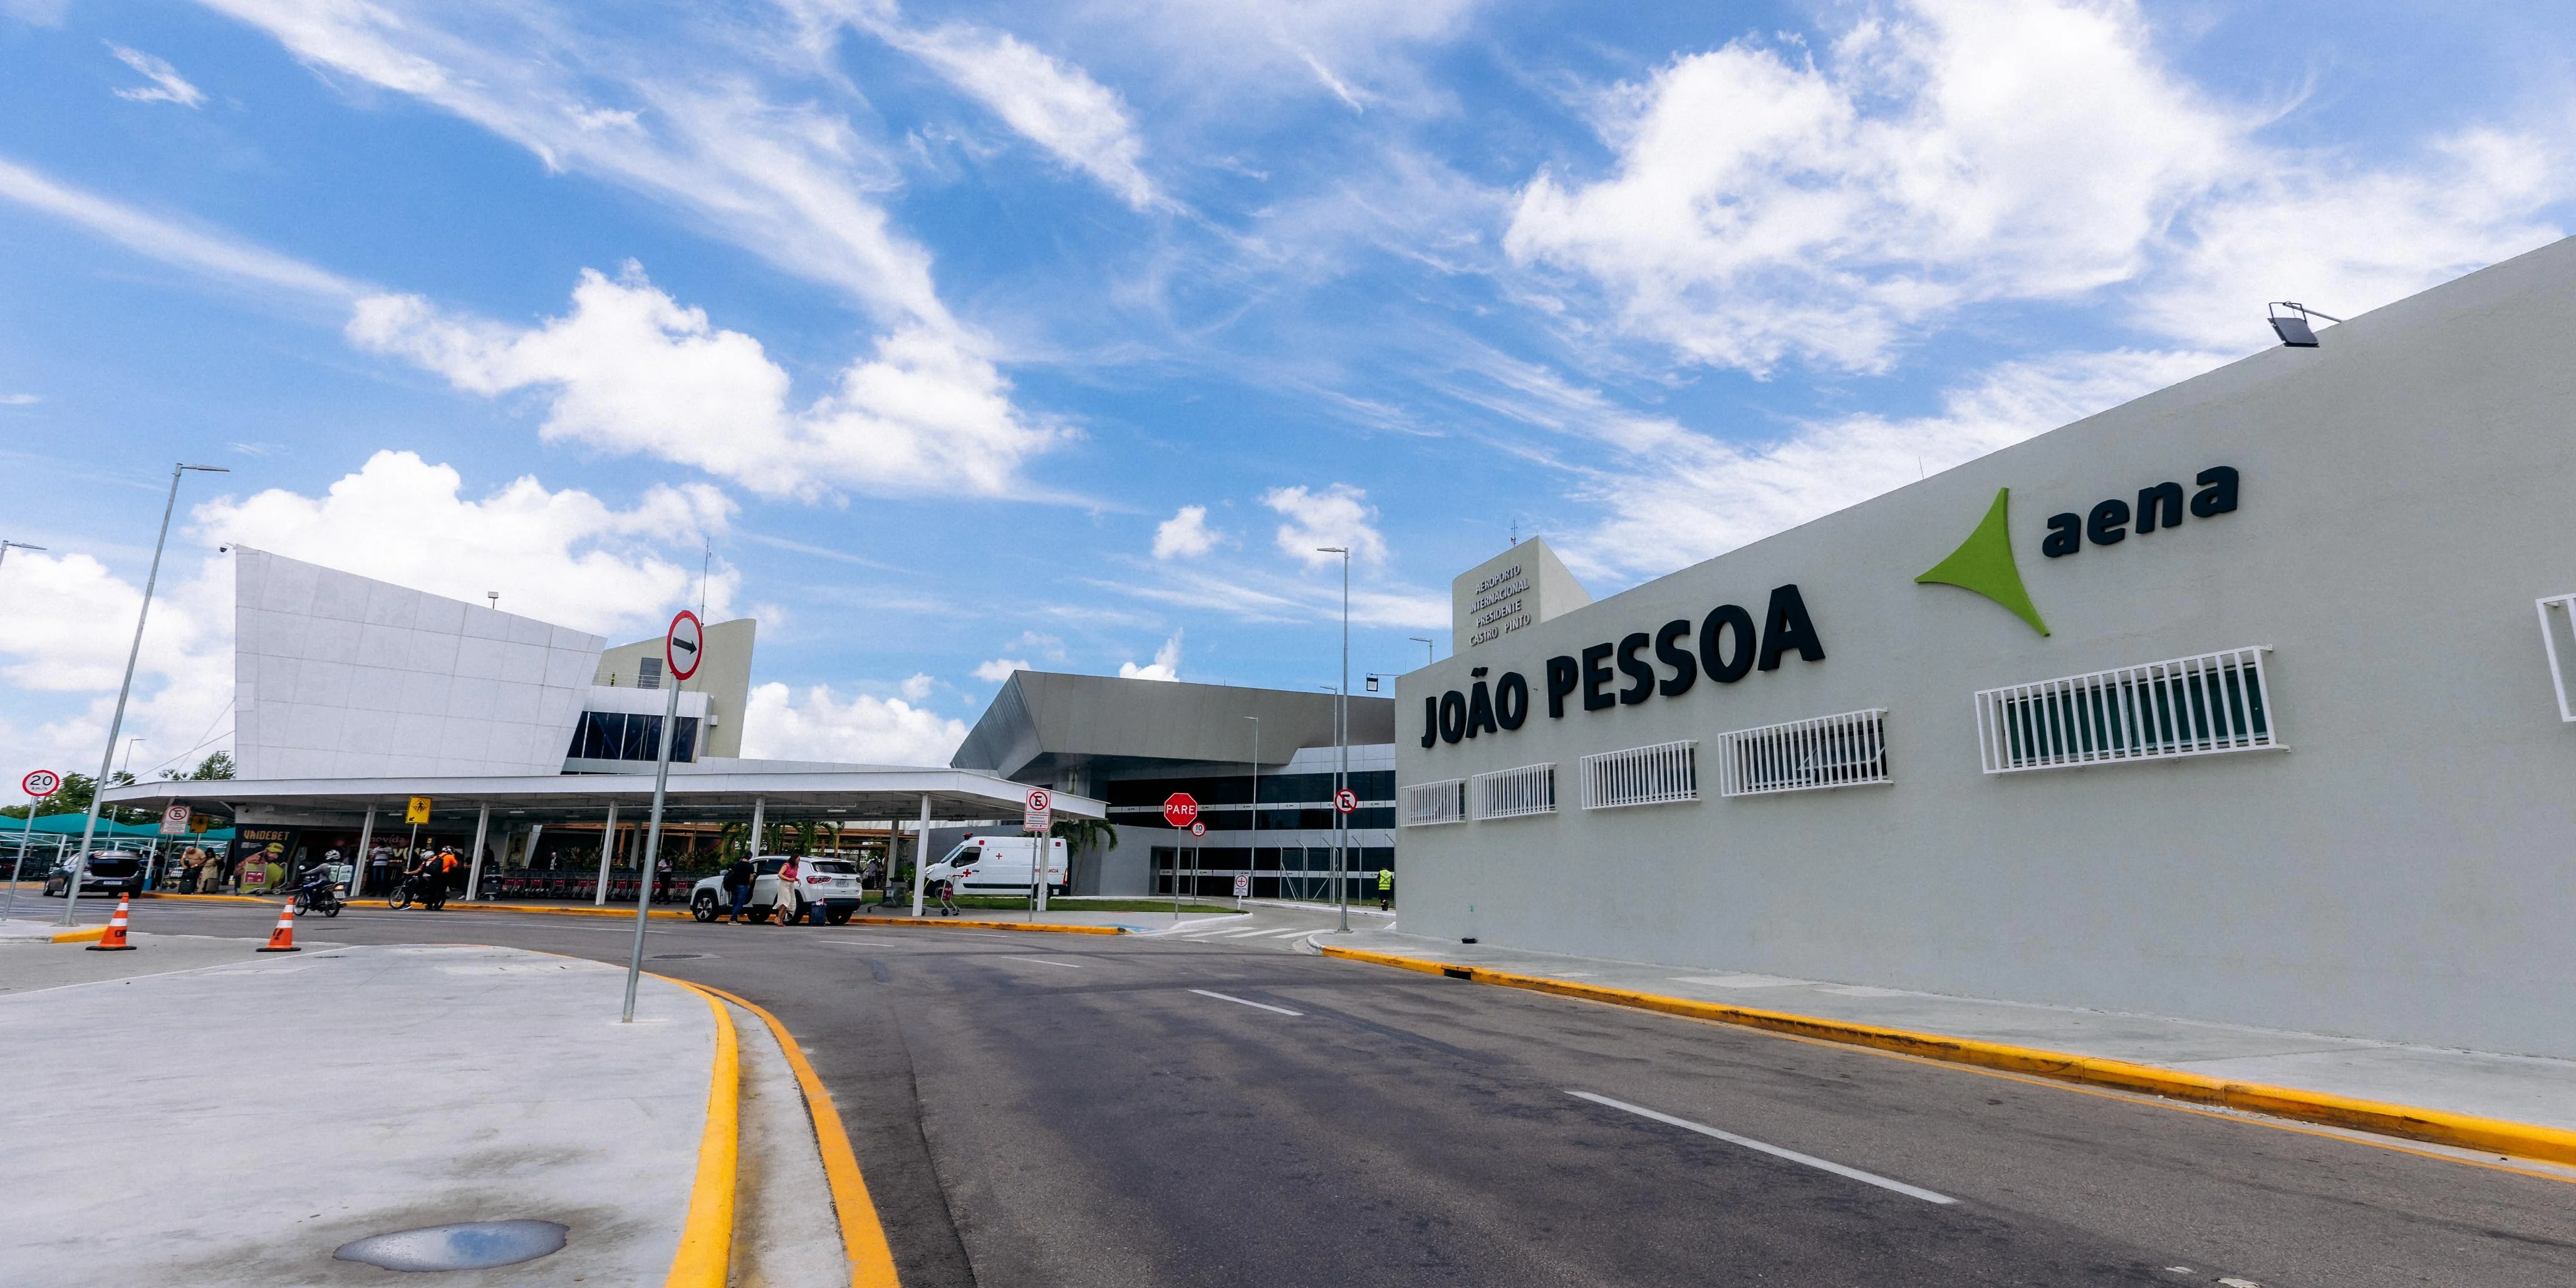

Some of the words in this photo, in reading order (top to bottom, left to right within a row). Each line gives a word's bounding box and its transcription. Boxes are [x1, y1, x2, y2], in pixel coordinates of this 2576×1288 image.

[2042, 466, 2239, 557] aena
[1476, 564, 1521, 594] AEROPORTO
[1469, 578, 1530, 614] INTERNACIONAL
[1476, 599, 1521, 627] PRESIDENTE
[1469, 627, 1499, 646] CASTRO
[1504, 614, 1531, 633] PINTO
[1421, 667, 1528, 748] JOÃO
[1546, 584, 1825, 718] PESSOA
[30, 775, 53, 786] 20
[1166, 804, 1195, 815] PARE
